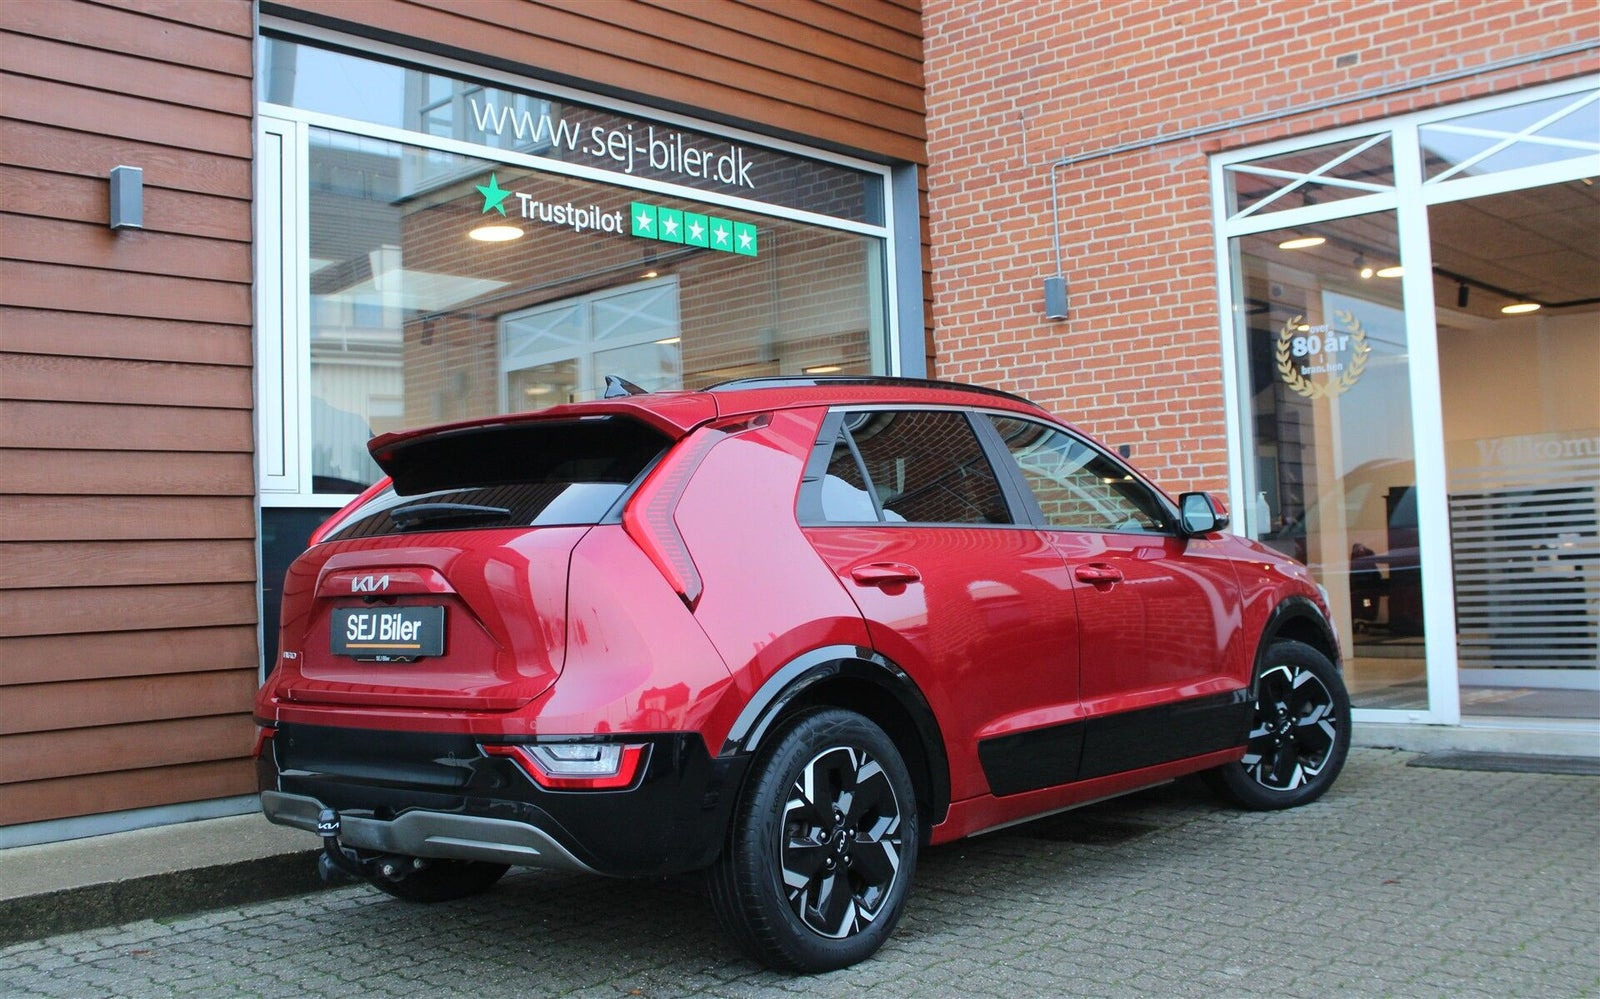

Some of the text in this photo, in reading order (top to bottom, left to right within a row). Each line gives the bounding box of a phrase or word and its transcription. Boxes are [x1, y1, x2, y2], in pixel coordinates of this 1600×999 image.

[471, 98, 755, 188] www.sej-biler.dk
[516, 192, 623, 233] Trustpilot
[1292, 330, 1349, 357] 80 år
[1475, 437, 1600, 464] Velkom
[351, 575, 389, 592] KIA
[346, 613, 421, 641] SEJ Biler
